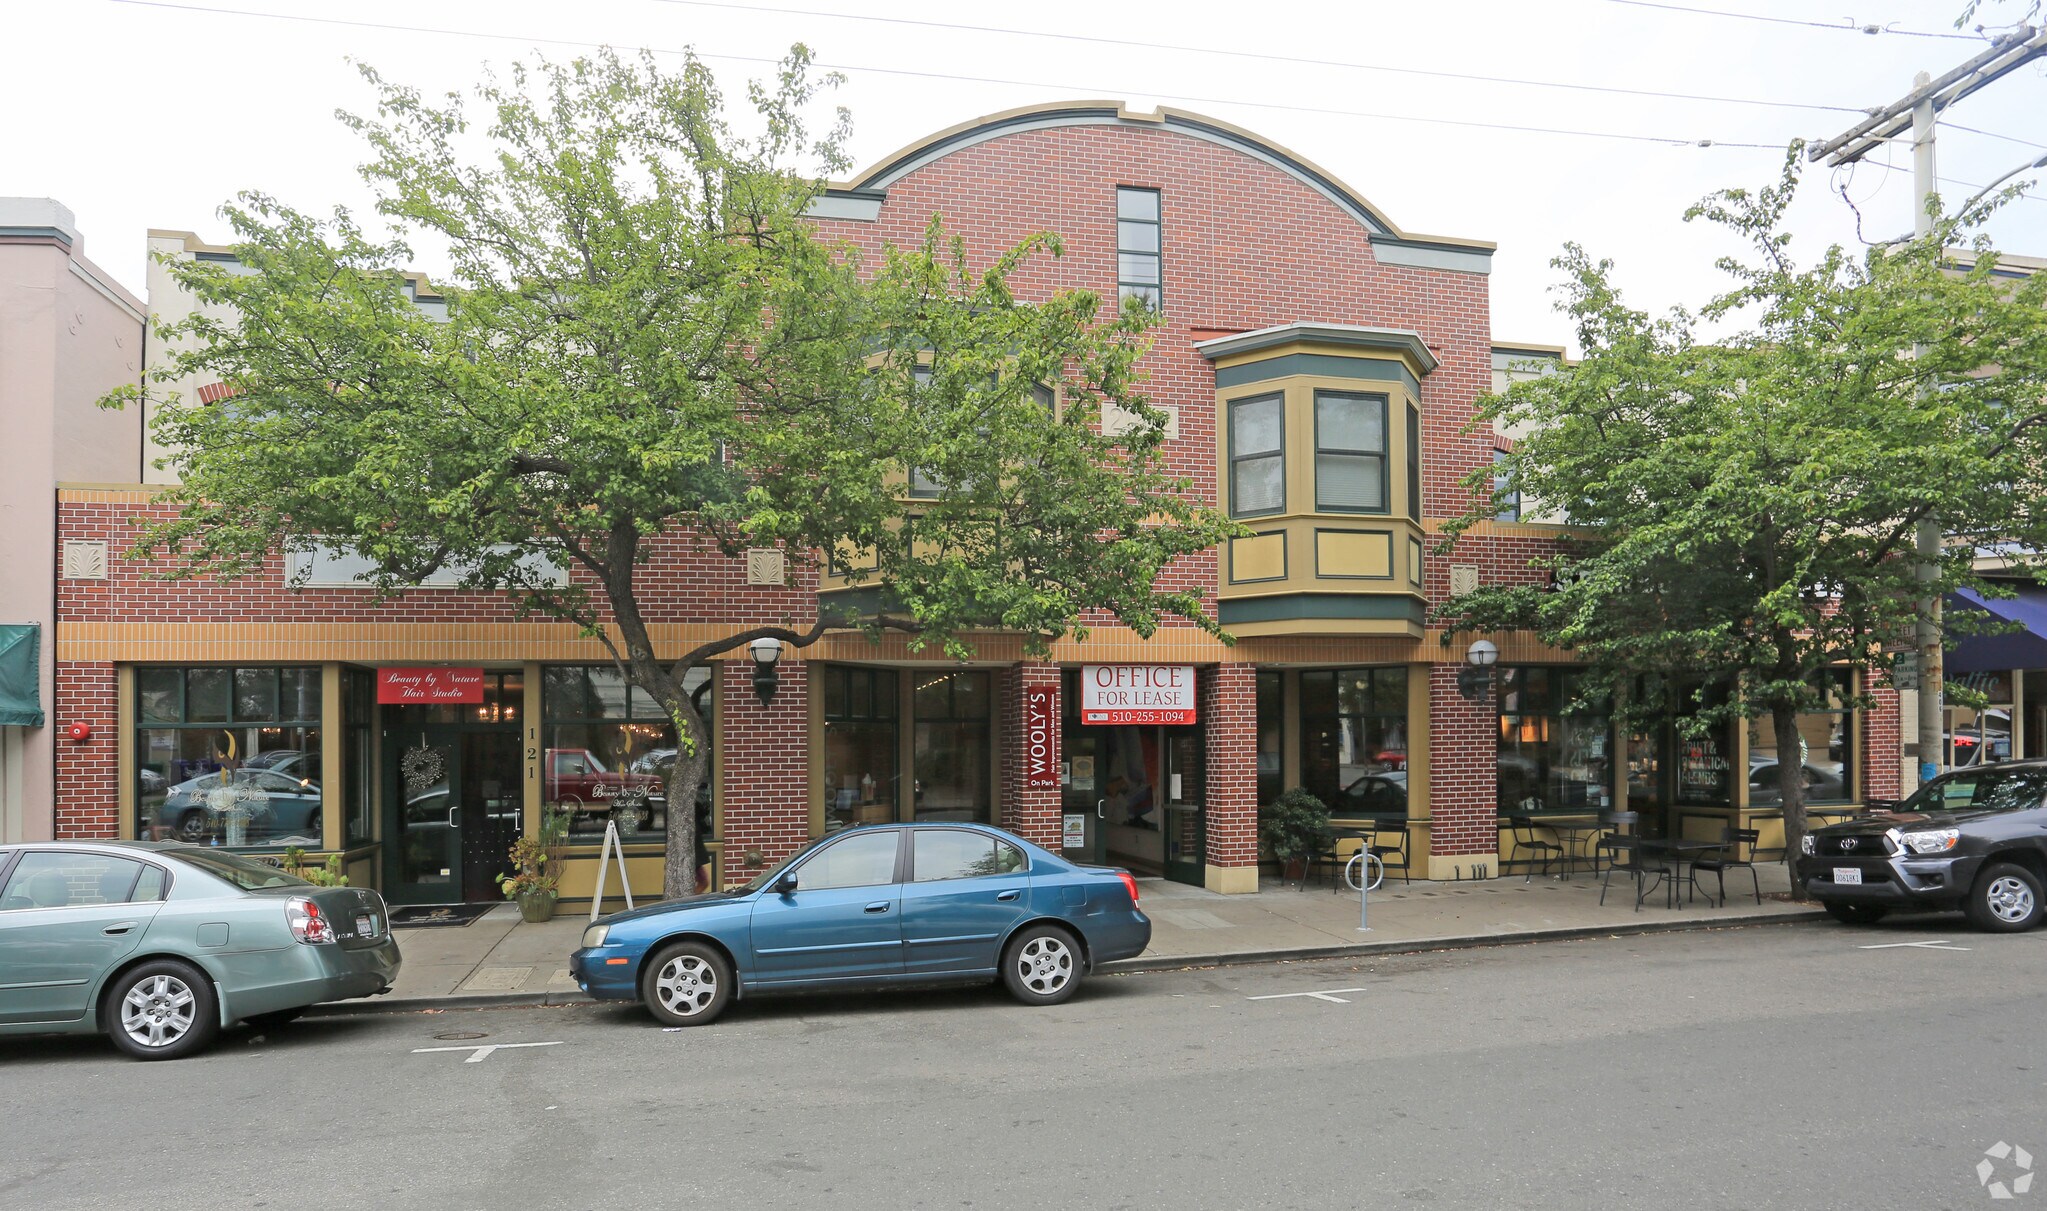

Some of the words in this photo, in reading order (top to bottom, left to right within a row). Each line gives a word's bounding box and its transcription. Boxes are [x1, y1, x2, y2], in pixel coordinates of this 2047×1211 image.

[1896, 654, 1903, 663] 2
[385, 672, 421, 687] Beauty
[425, 672, 437, 687] by
[446, 671, 480, 683] Nature
[1096, 666, 1183, 688] OFFICE
[1944, 671, 2000, 692] altic
[402, 686, 425, 698] Hair
[432, 687, 463, 698] Studio
[1097, 691, 1129, 706] FOR
[1134, 691, 1182, 706] LEASE
[1112, 711, 1185, 722] 510-255-1094
[1030, 693, 1046, 775] WOOLY'S
[592, 784, 620, 798] Beauty
[633, 784, 664, 798] Nature
